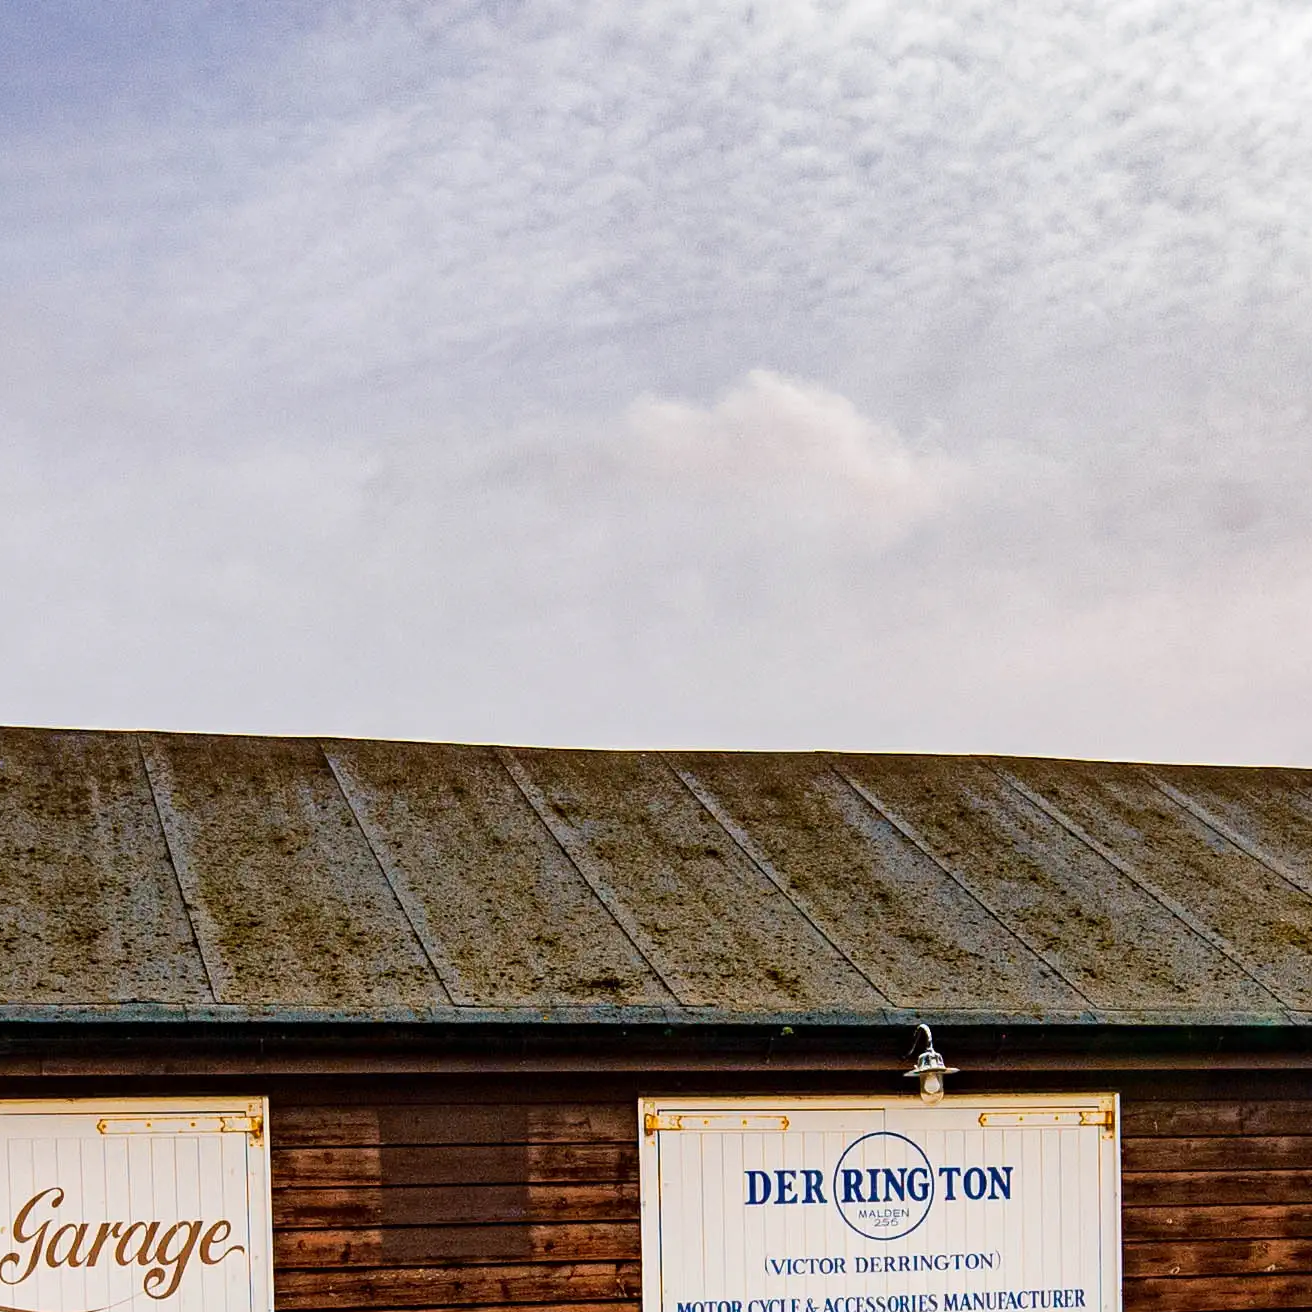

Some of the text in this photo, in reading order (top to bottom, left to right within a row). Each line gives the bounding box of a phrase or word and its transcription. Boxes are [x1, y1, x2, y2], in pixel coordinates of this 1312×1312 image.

[858, 1208, 910, 1219] MALDEN
[764, 1252, 1001, 1276] (VICTOR DERRINGTON)
[943, 1288, 1086, 1312] MANUFACTURER
